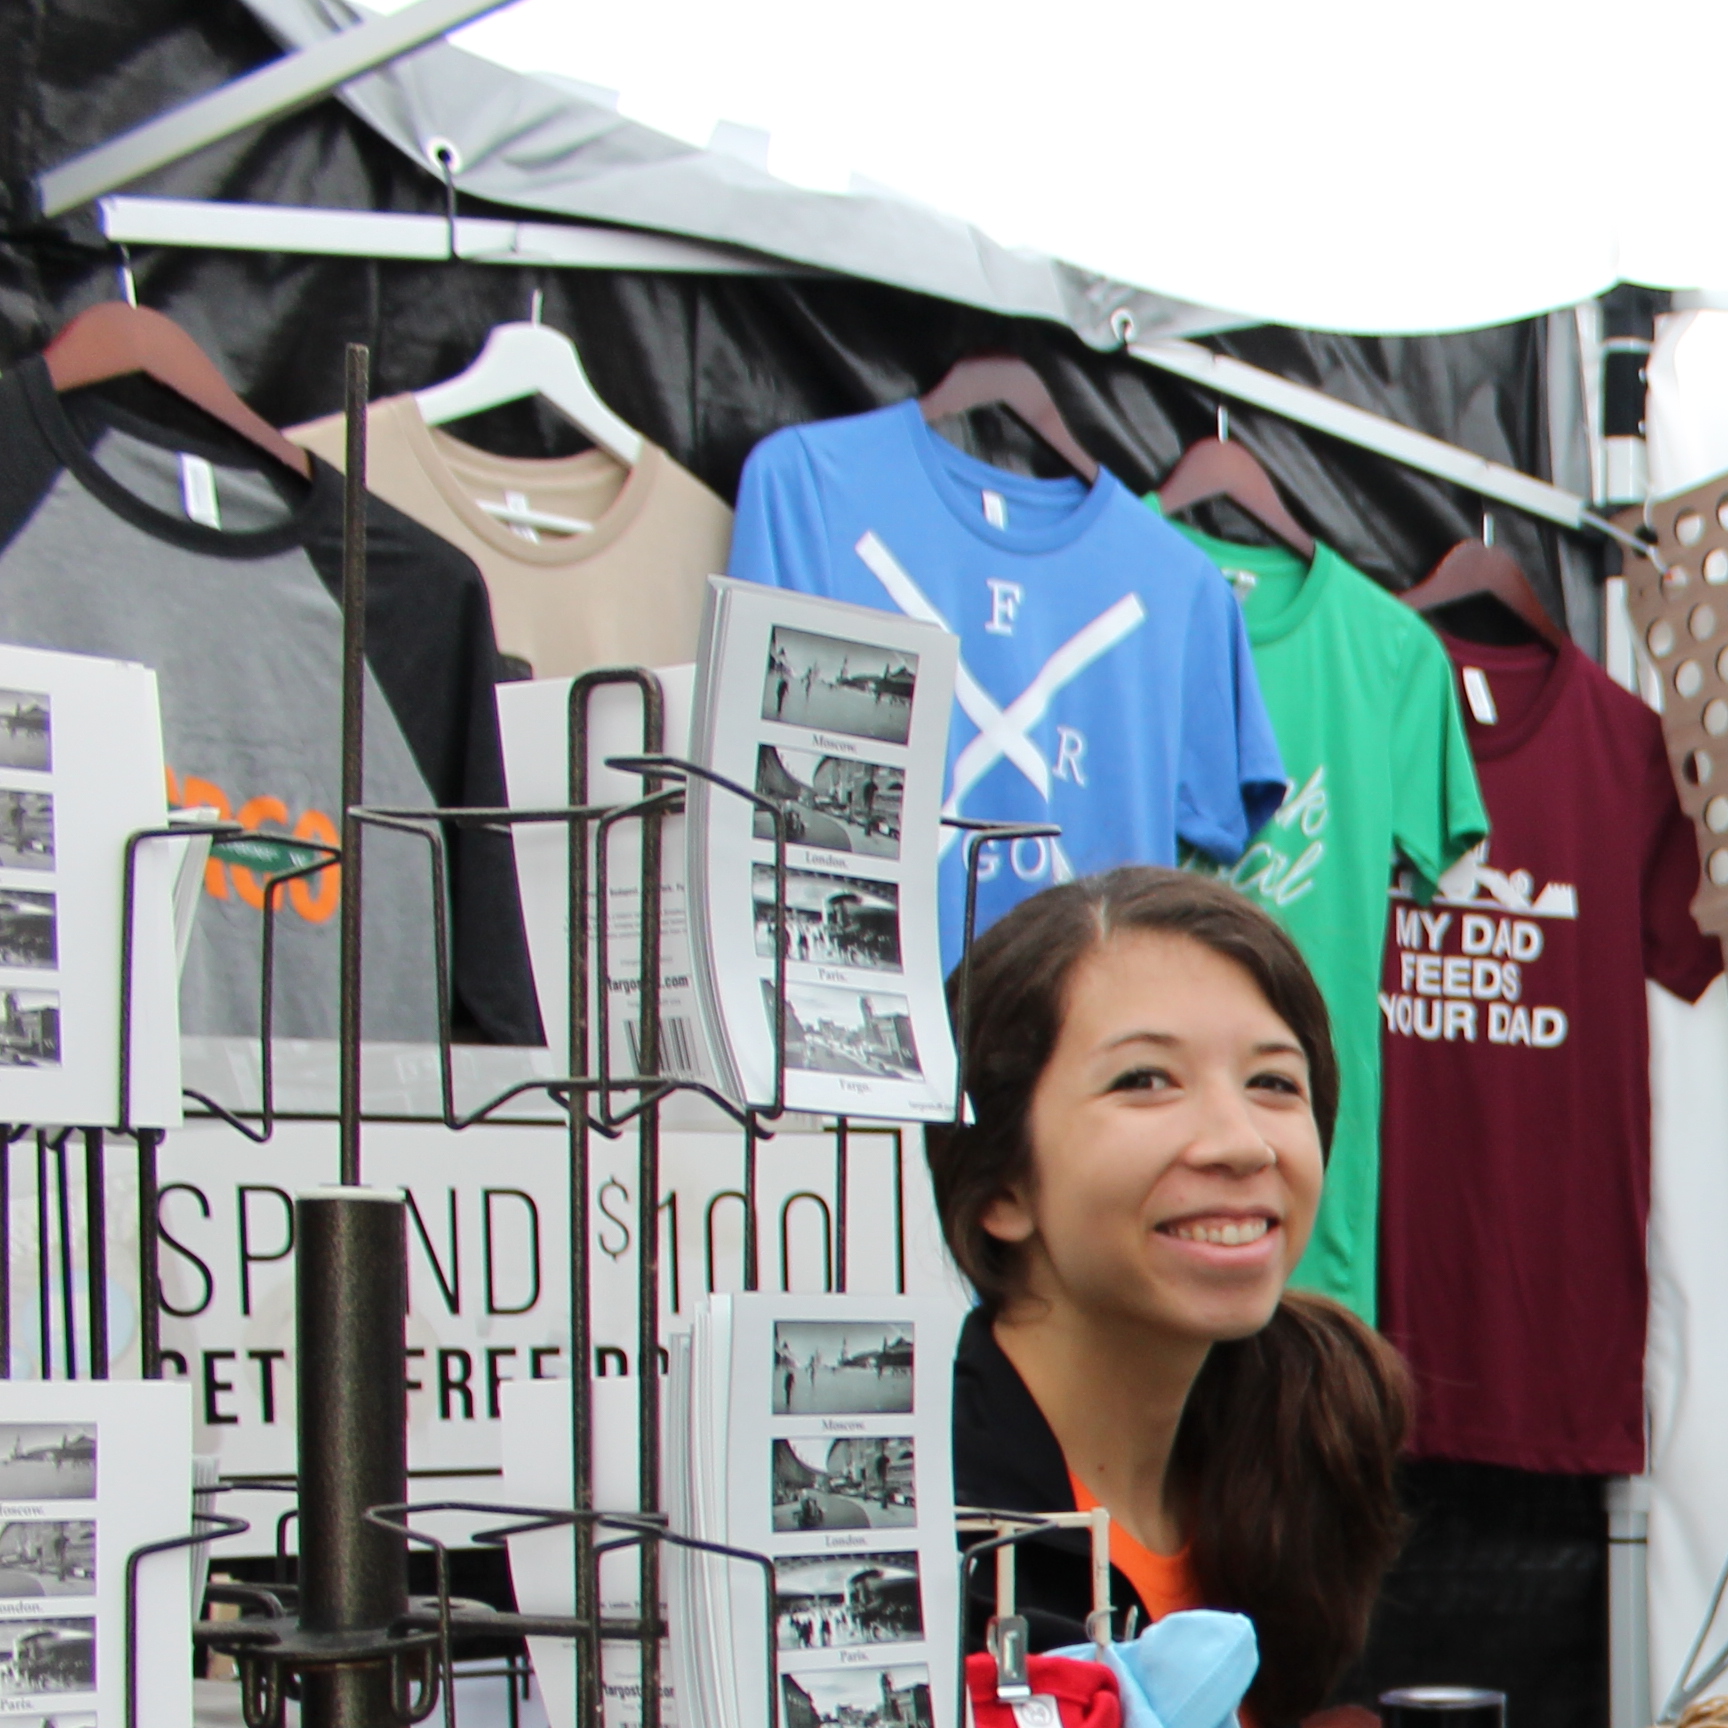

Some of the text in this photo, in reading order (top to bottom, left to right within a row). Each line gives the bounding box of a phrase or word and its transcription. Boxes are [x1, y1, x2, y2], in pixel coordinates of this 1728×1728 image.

[1396, 905, 1544, 960] MY DAD
[1401, 955, 1522, 998] FEEDS
[1378, 993, 1568, 1048] YOUR DAD
[156, 1183, 541, 1318] SPND
